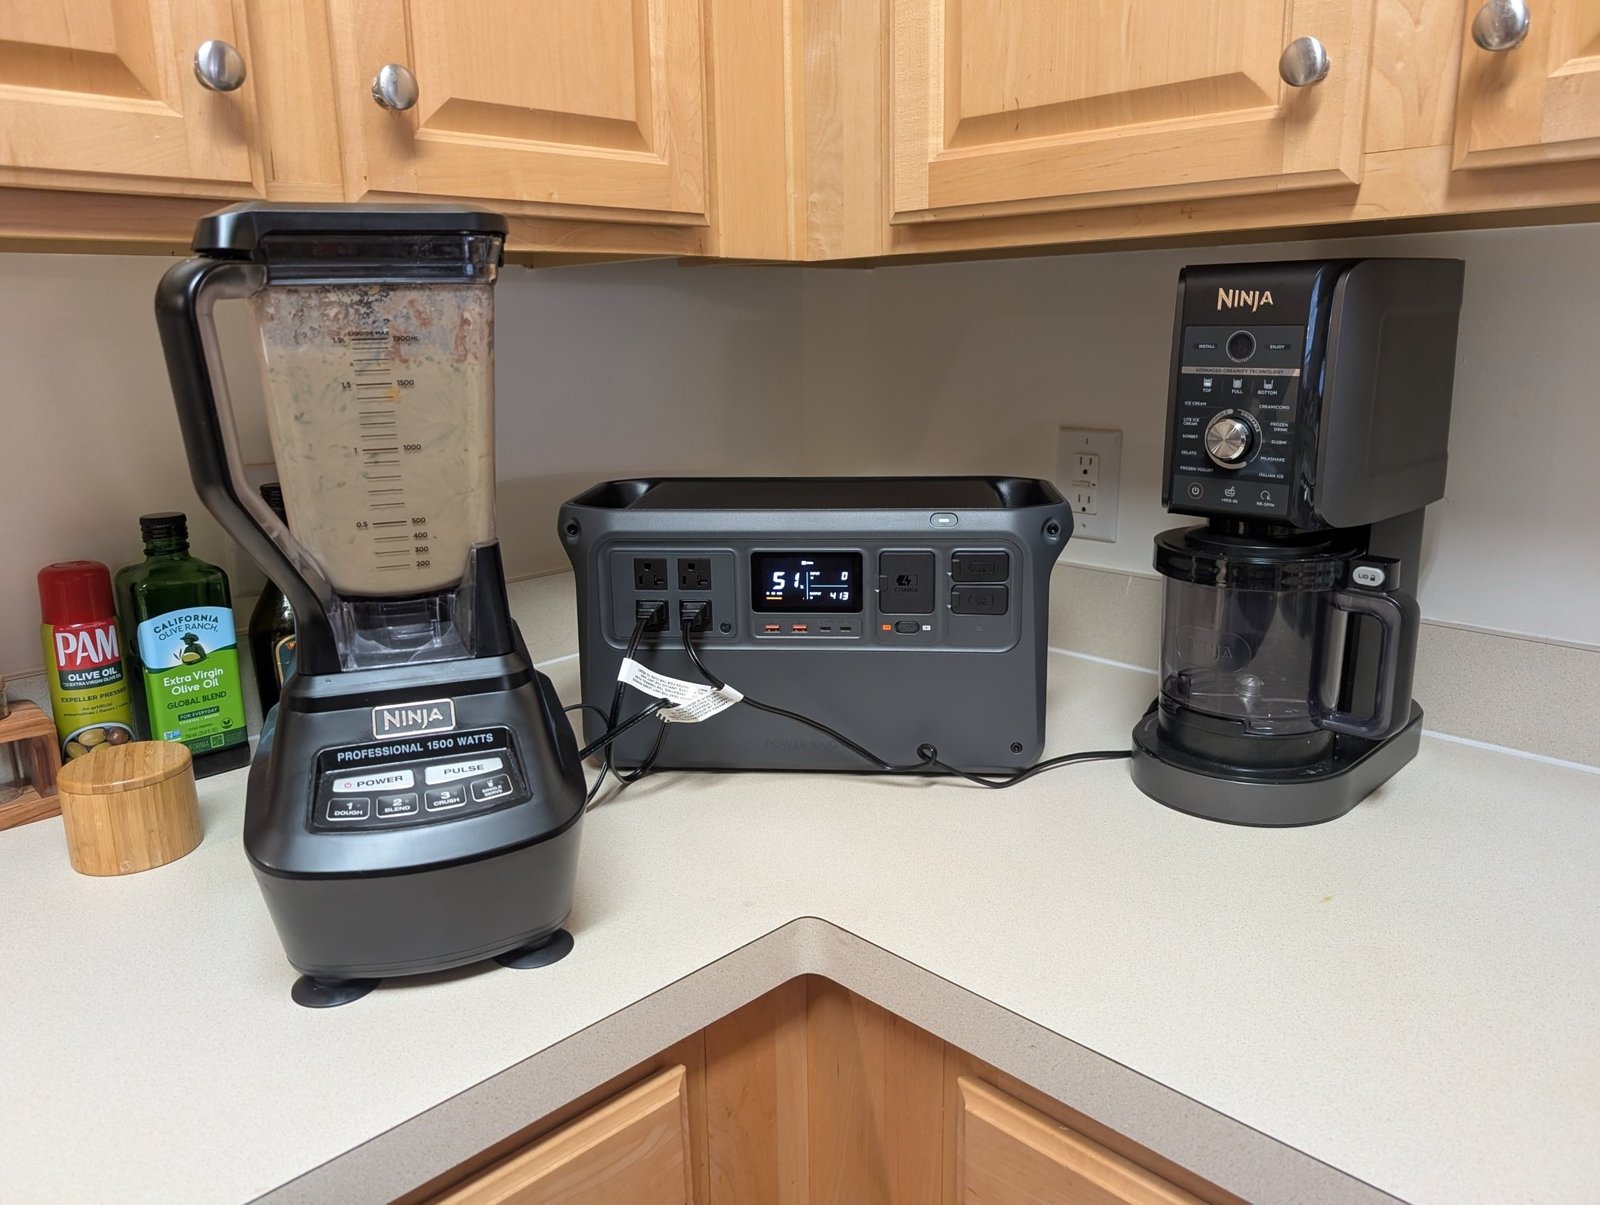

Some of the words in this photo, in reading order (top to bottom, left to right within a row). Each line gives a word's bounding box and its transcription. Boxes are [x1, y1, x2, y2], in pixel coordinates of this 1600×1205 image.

[1217, 287, 1274, 312] NINJA
[841, 571, 849, 581] 0
[829, 592, 849, 600] 413
[153, 614, 219, 633] CALIFORNIA
[158, 624, 184, 641] OLIVE
[55, 625, 119, 667] PAM
[68, 670, 100, 682] OLIVE
[101, 667, 118, 677] OIL
[163, 674, 192, 687] Extra
[192, 667, 224, 680] Virgin
[171, 684, 200, 695] Olive
[203, 678, 219, 688] Oil
[60, 695, 98, 703] EXPELLER
[166, 696, 200, 710] GLOBAL
[202, 691, 227, 702] BLEND
[192, 707, 218, 718] EVERYDAY
[383, 708, 444, 731] NINJA
[337, 742, 424, 762] PROFESSIONAL
[427, 738, 454, 751] 1500
[457, 732, 494, 746] WATTS
[443, 764, 485, 775] PULSE
[356, 775, 403, 788] POWER
[433, 797, 460, 806] CRUSH
[440, 791, 451, 799] 3
[346, 802, 353, 810] 1
[384, 804, 411, 813] BLEND
[392, 798, 403, 806] 2
